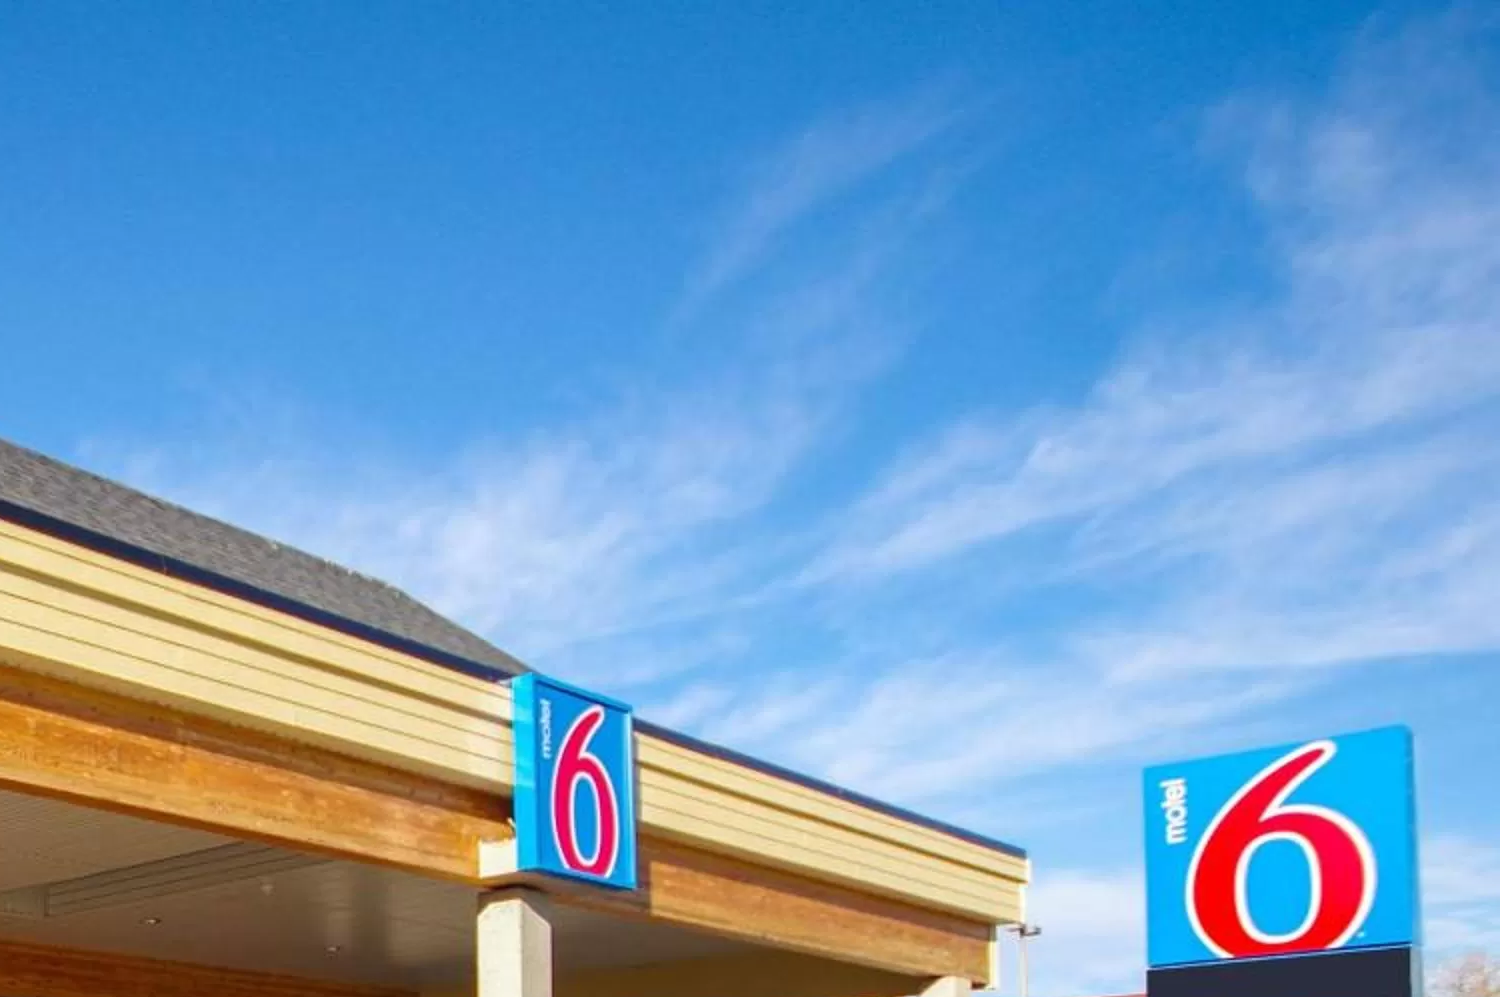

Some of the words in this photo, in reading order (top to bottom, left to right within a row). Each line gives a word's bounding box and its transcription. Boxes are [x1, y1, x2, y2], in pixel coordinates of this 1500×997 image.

[540, 698, 551, 759] motel
[551, 703, 619, 879] 6
[1160, 778, 1188, 844] motel
[1185, 738, 1378, 960] 6
